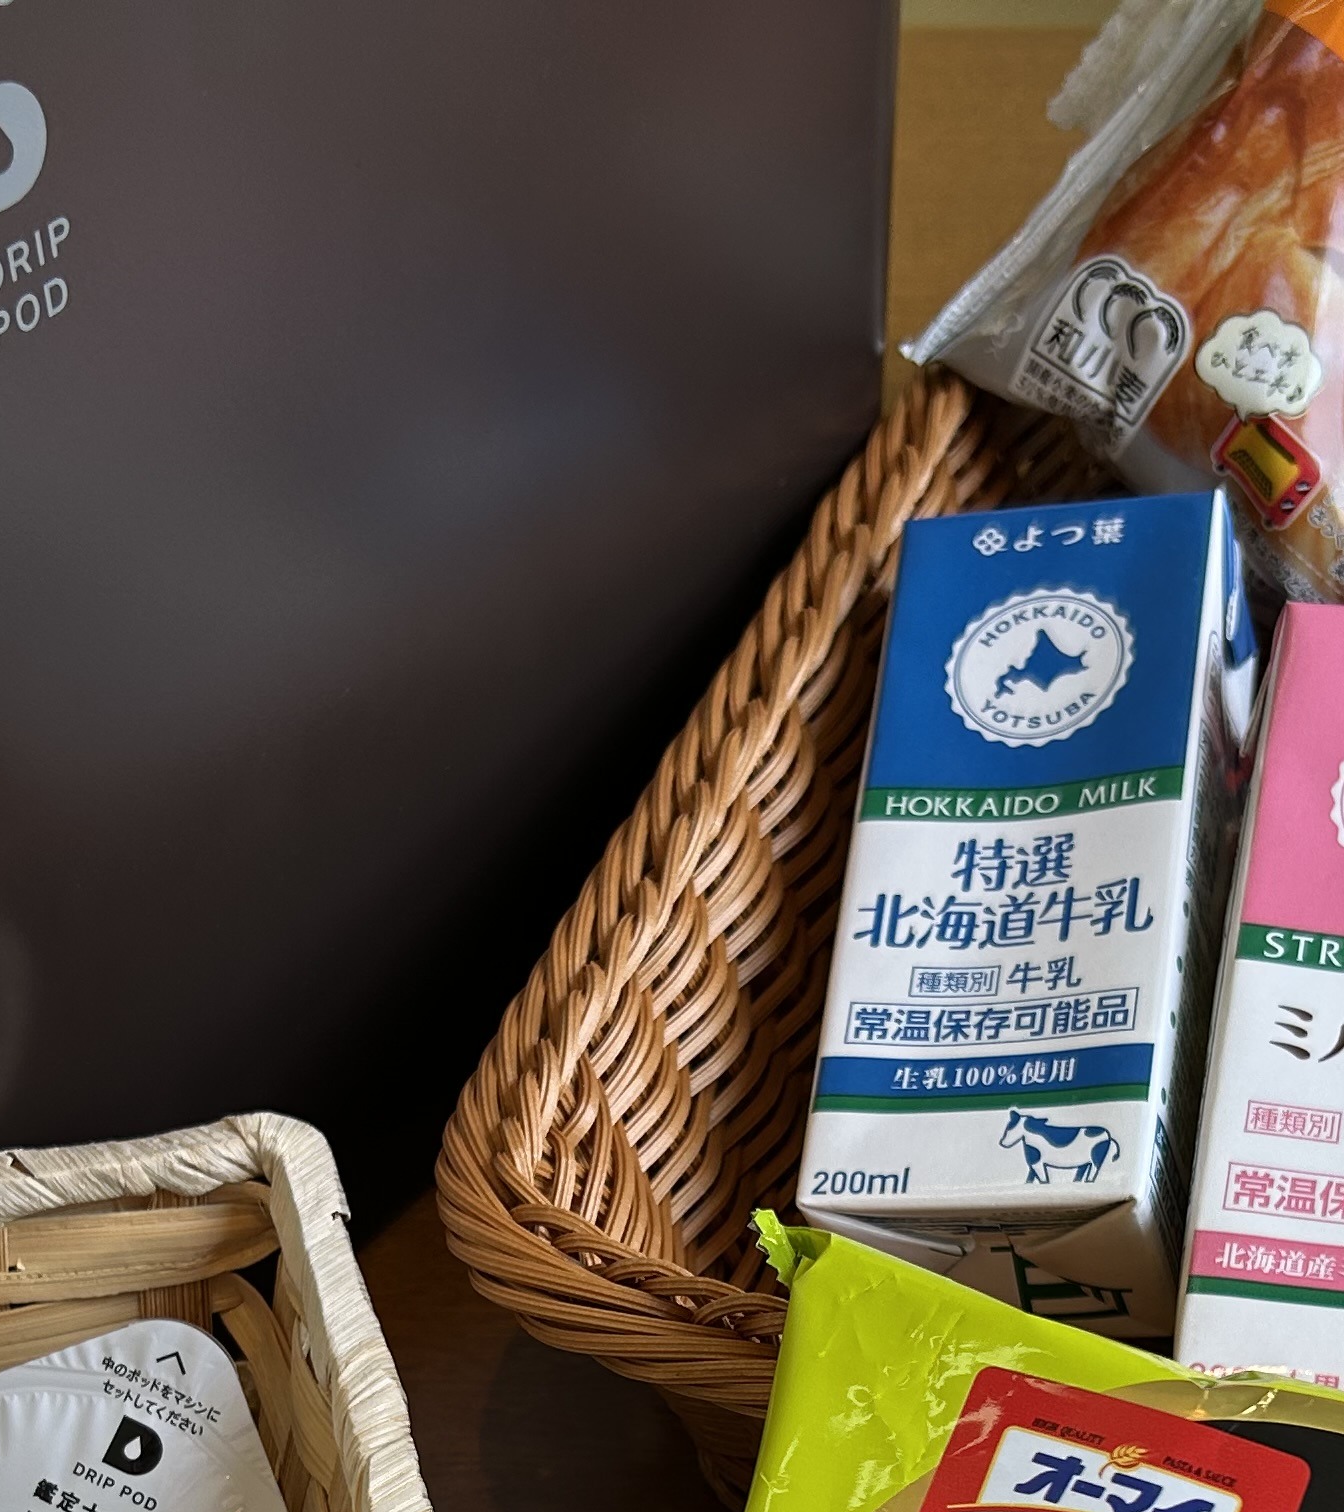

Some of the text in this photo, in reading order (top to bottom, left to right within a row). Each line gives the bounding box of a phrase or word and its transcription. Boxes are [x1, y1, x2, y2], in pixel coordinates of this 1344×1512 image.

[1013, 518, 1126, 553] よつ葉
[978, 605, 1108, 648] HOKKAIDO
[978, 689, 1096, 730] YOTSUBA
[885, 775, 1157, 818] HOKKAIDO MILK
[952, 832, 1076, 894] 特選
[852, 877, 1154, 950] 北海道牛乳
[915, 956, 1082, 995] 種類別 牛乳
[853, 993, 1130, 1044] 常温保存可能品
[890, 1057, 1077, 1092] 生乳100%使用
[1249, 1105, 1340, 1140] 種類別
[811, 1167, 911, 1197] 200ml
[101, 1355, 222, 1424] 中のポッドをマシンに
[101, 1378, 205, 1438] セットしてください
[71, 1461, 116, 1492] DRIP
